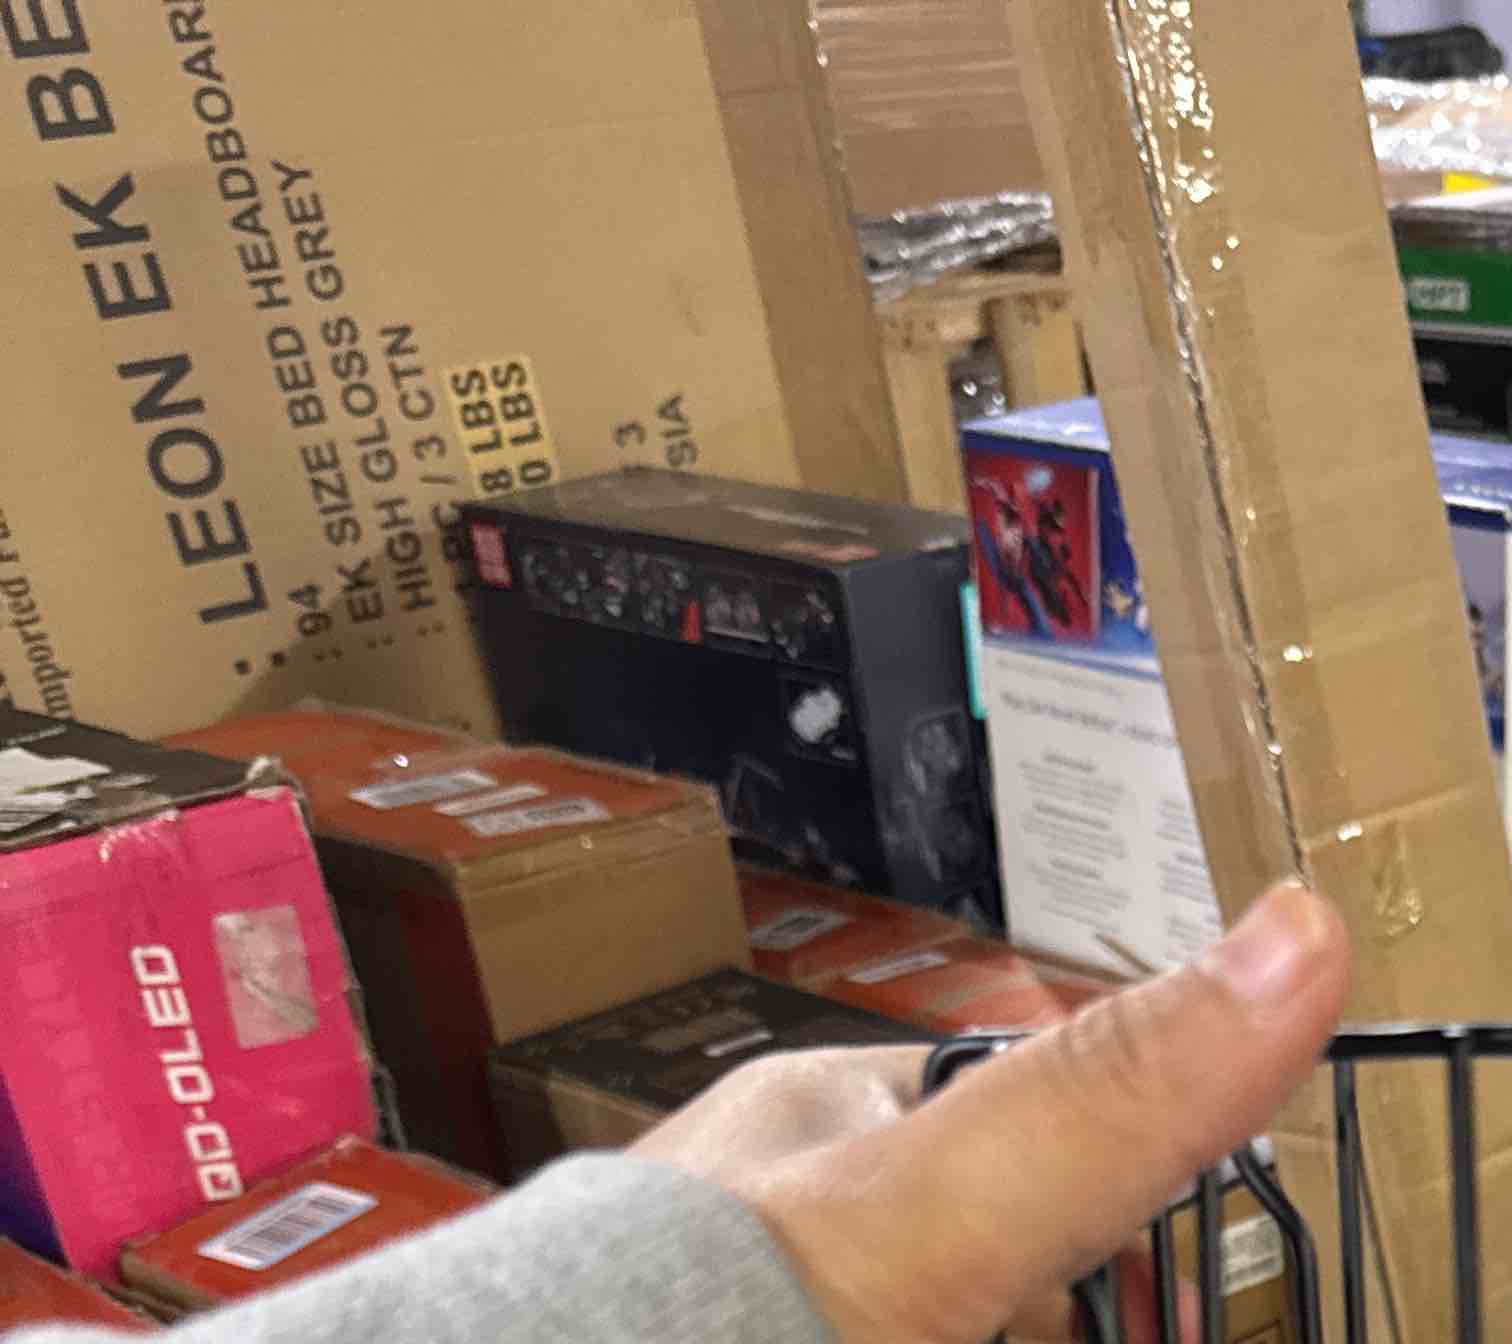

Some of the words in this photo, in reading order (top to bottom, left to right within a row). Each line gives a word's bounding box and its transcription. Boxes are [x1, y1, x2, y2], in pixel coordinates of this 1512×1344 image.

[163, 0, 291, 309] HEADBOAR
[54, 170, 172, 321] EK
[270, 159, 347, 302] GREY
[266, 325, 327, 429] BED
[320, 315, 398, 483] GLOSS
[381, 323, 436, 421] CTN
[451, 368, 504, 456] LBS
[490, 361, 544, 448] LBS
[117, 353, 268, 623] LEON
[301, 440, 362, 547] SIZE
[336, 557, 384, 624] EK
[374, 498, 436, 612] HIGH
[0, 568, 74, 718] mported
